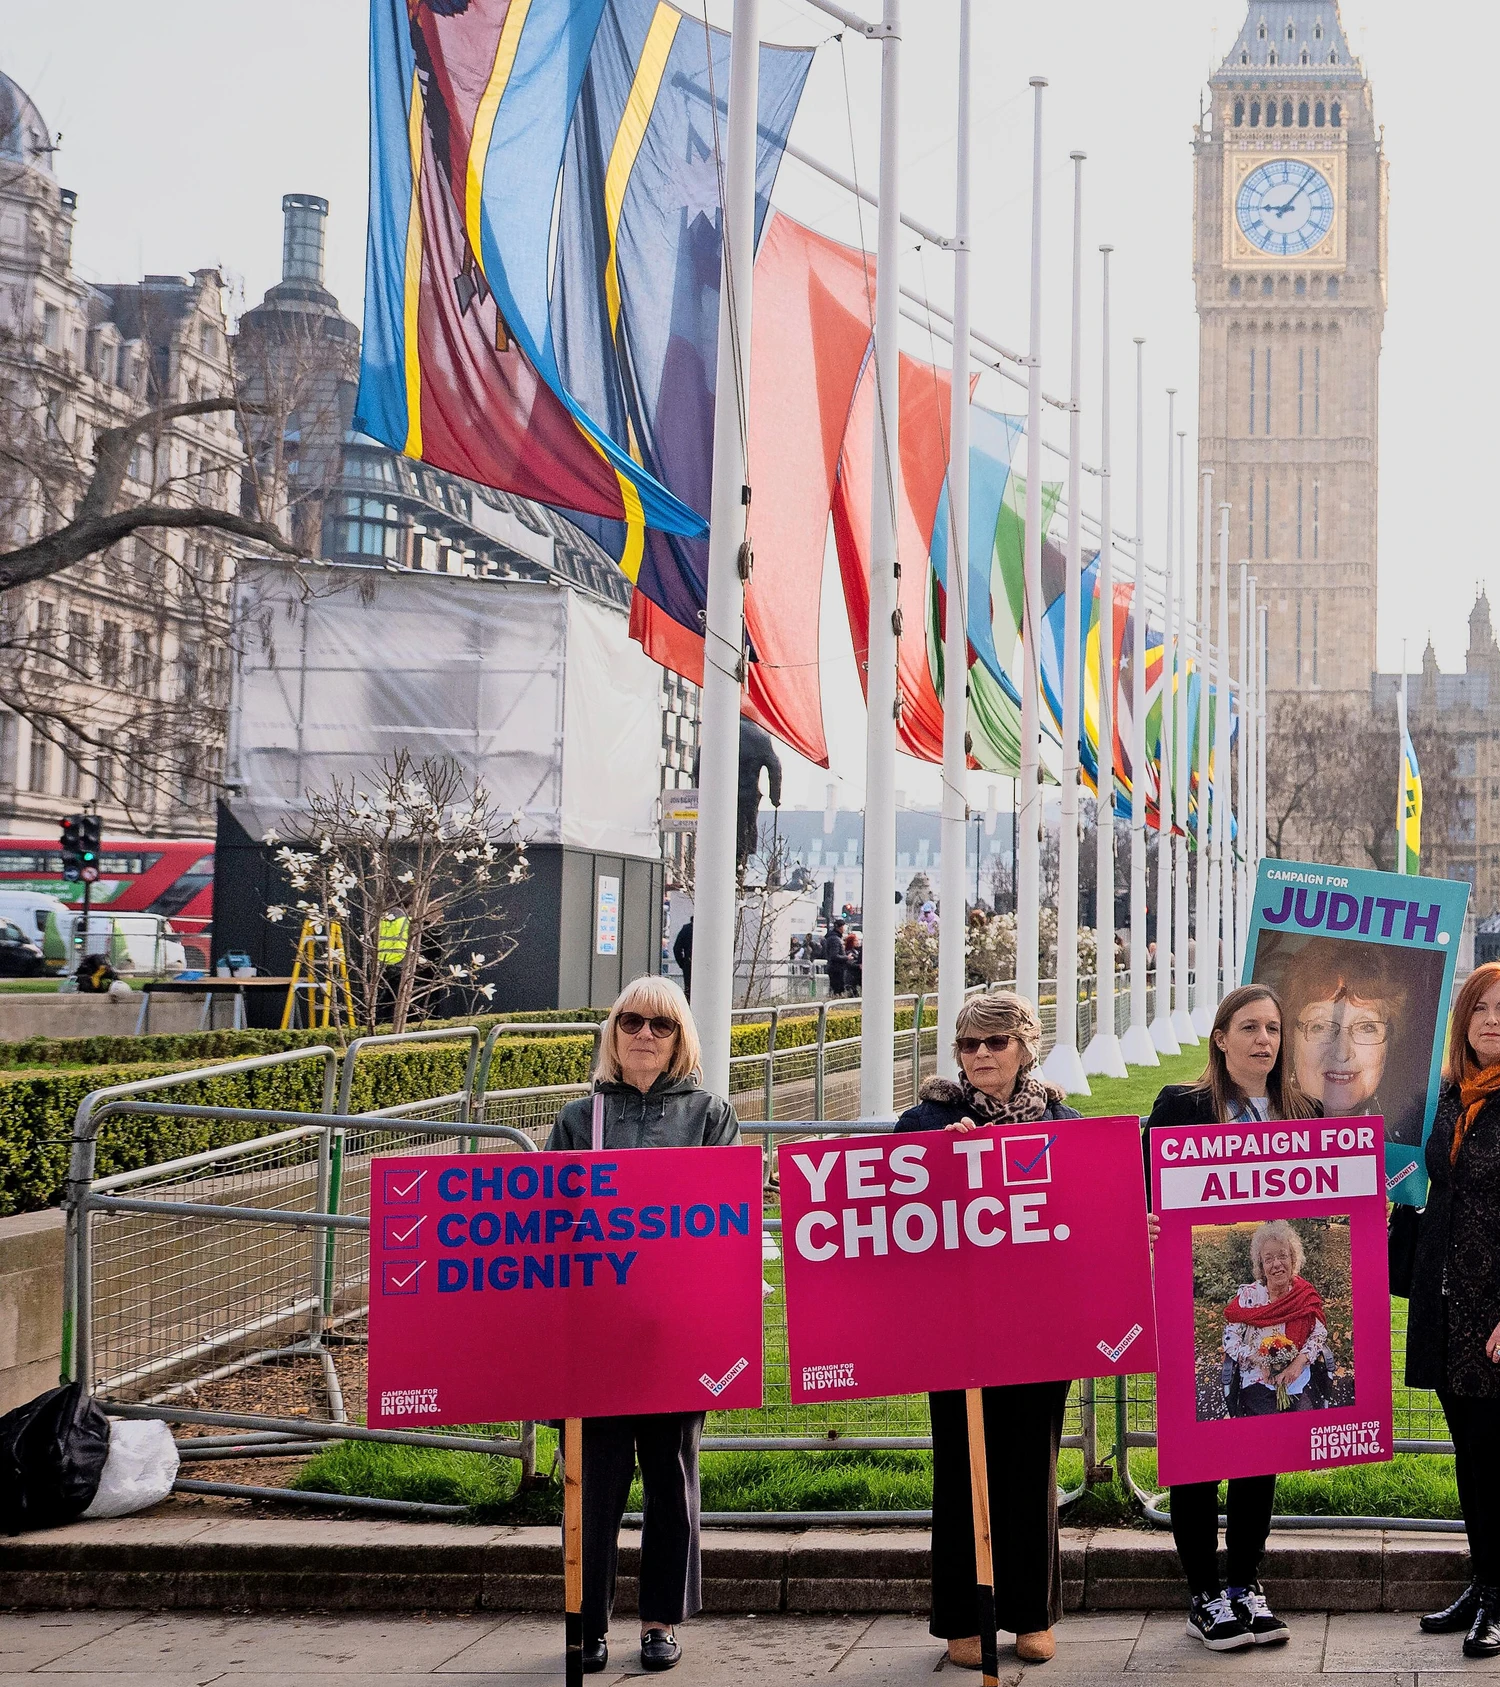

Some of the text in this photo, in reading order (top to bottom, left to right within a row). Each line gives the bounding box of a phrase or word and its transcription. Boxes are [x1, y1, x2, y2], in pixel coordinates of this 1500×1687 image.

[1267, 869, 1349, 888] CAMPAIGN FOR
[1262, 887, 1450, 945] JUDITH.
[1160, 1127, 1375, 1161] CAMPAIGN FOR
[437, 1163, 619, 1202] CHOICE
[791, 1144, 931, 1203] YES
[1200, 1165, 1340, 1202] ALISON
[437, 1203, 750, 1248] COMPASSION
[794, 1192, 1071, 1262] CHOICE.
[437, 1251, 639, 1293] DIGNITY
[1100, 1342, 1113, 1356] YES
[702, 1375, 716, 1390] YES
[803, 1369, 854, 1381] DIGNITY
[803, 1378, 858, 1390] IN DYING.
[381, 1389, 421, 1397] CAMPAIGN
[381, 1394, 437, 1407] DIGNITY
[381, 1403, 441, 1415] IN DYING.
[1311, 1421, 1379, 1434] CAMPAIGN FOR
[1311, 1429, 1379, 1448] DIGNITY
[1311, 1442, 1385, 1460] IN DYING.
